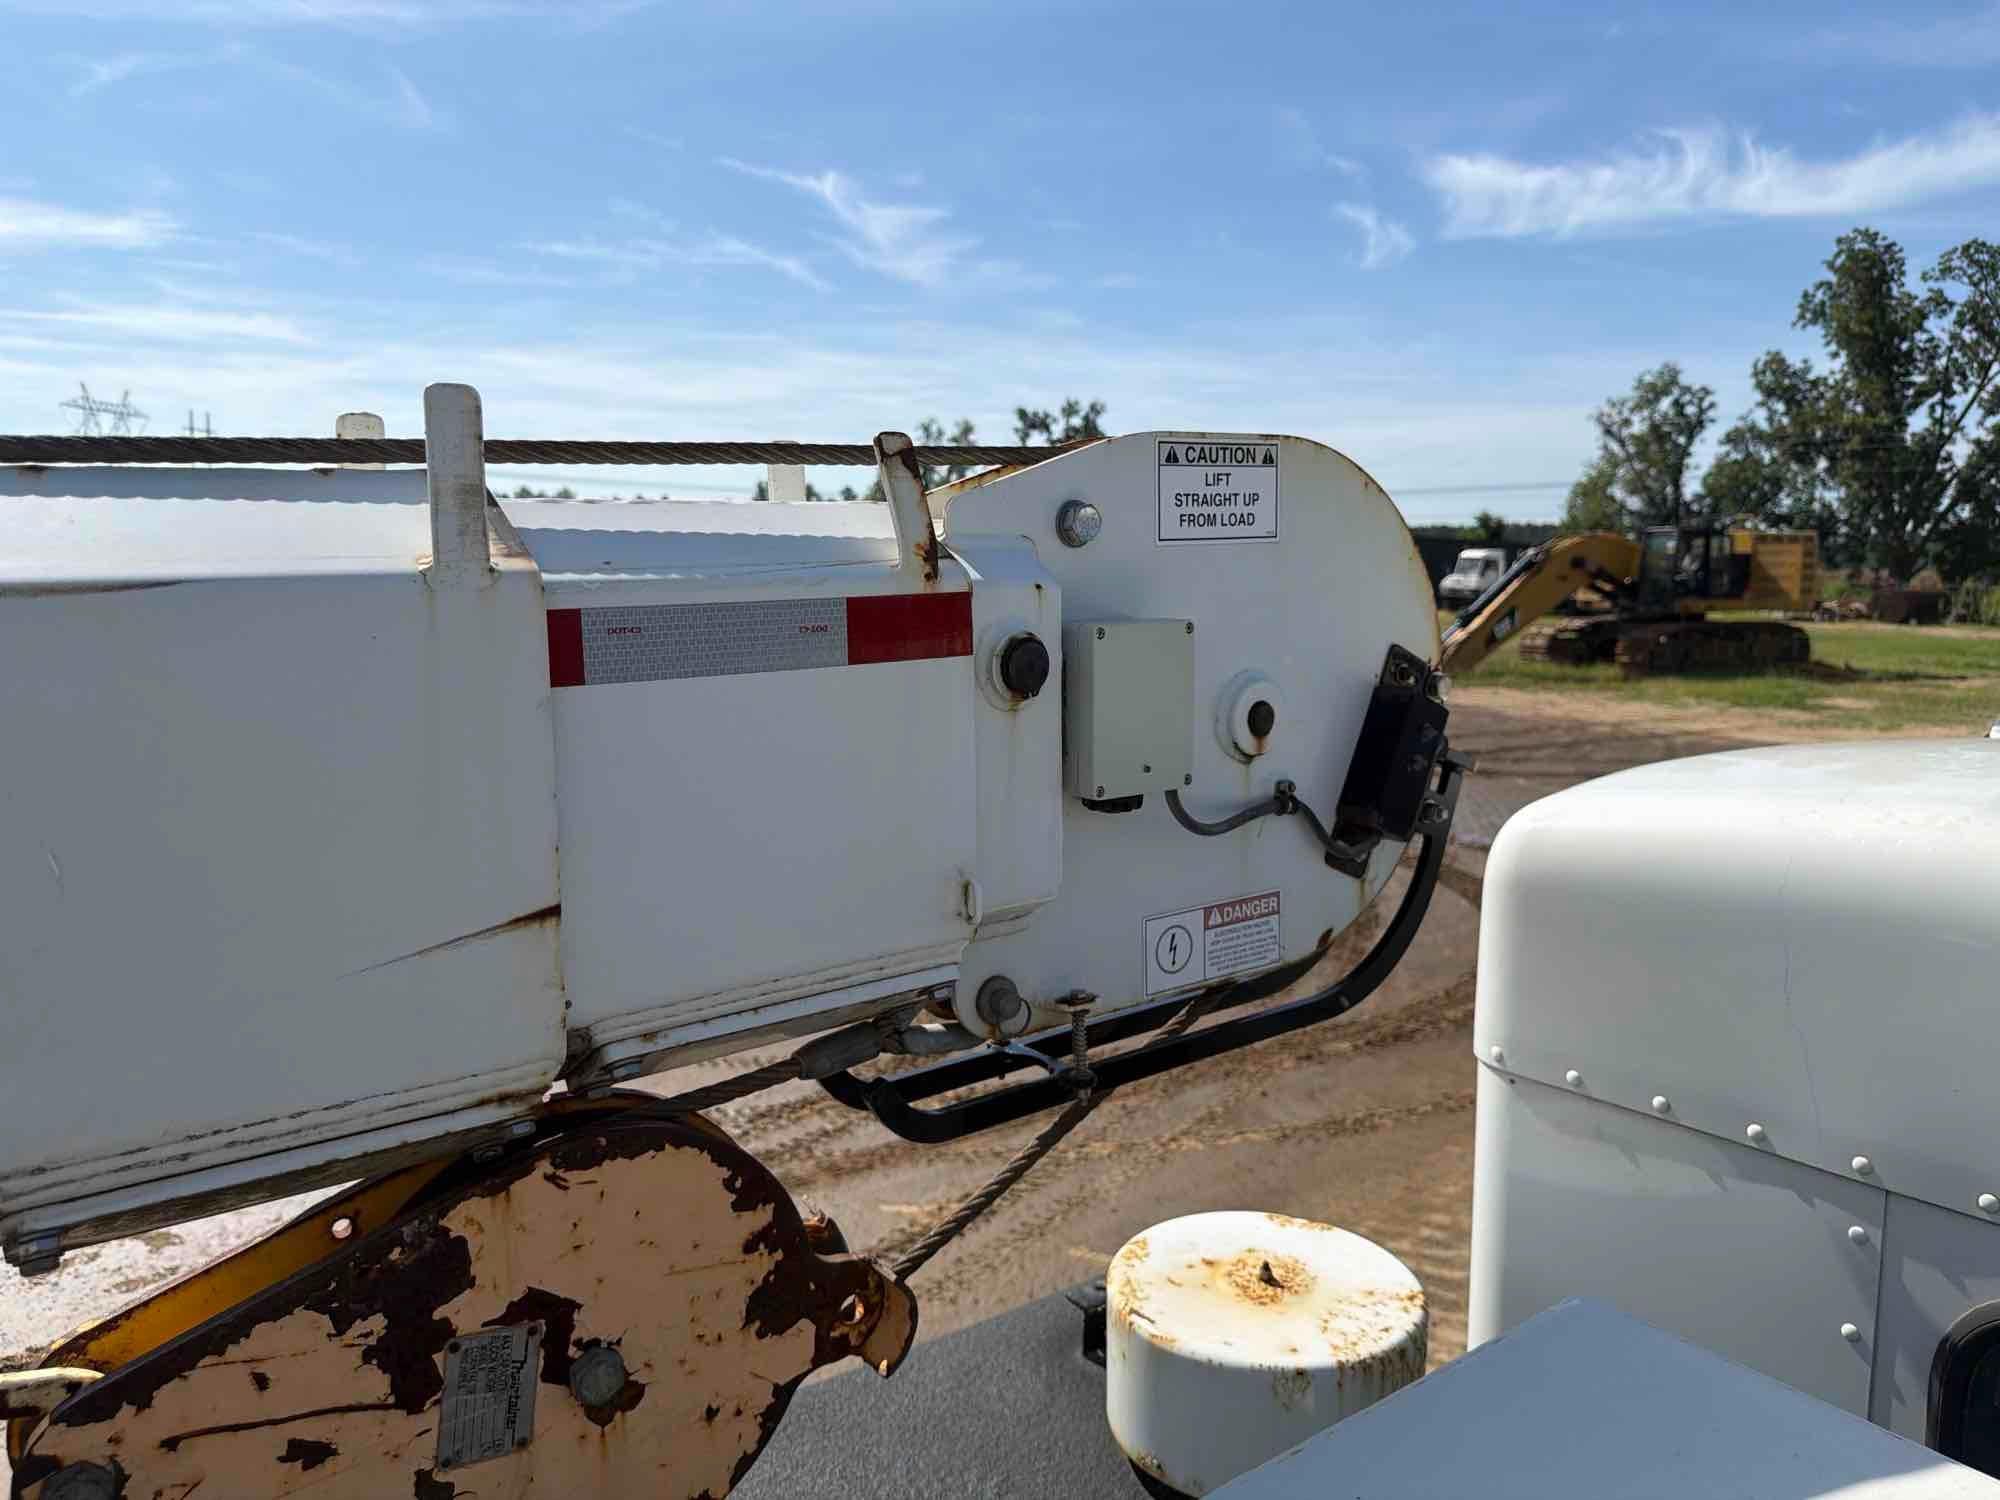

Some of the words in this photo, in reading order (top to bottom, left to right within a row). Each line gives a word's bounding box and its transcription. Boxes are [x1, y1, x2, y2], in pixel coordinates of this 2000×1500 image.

[1185, 446, 1256, 464] CAUTION
[1205, 472, 1231, 487] LIFT
[1174, 493, 1240, 507] STRAIGHT
[1243, 493, 1260, 507] UP
[1179, 513, 1217, 528] FROM
[1220, 512, 1256, 527] LOAD
[1223, 896, 1278, 922] DANGER
